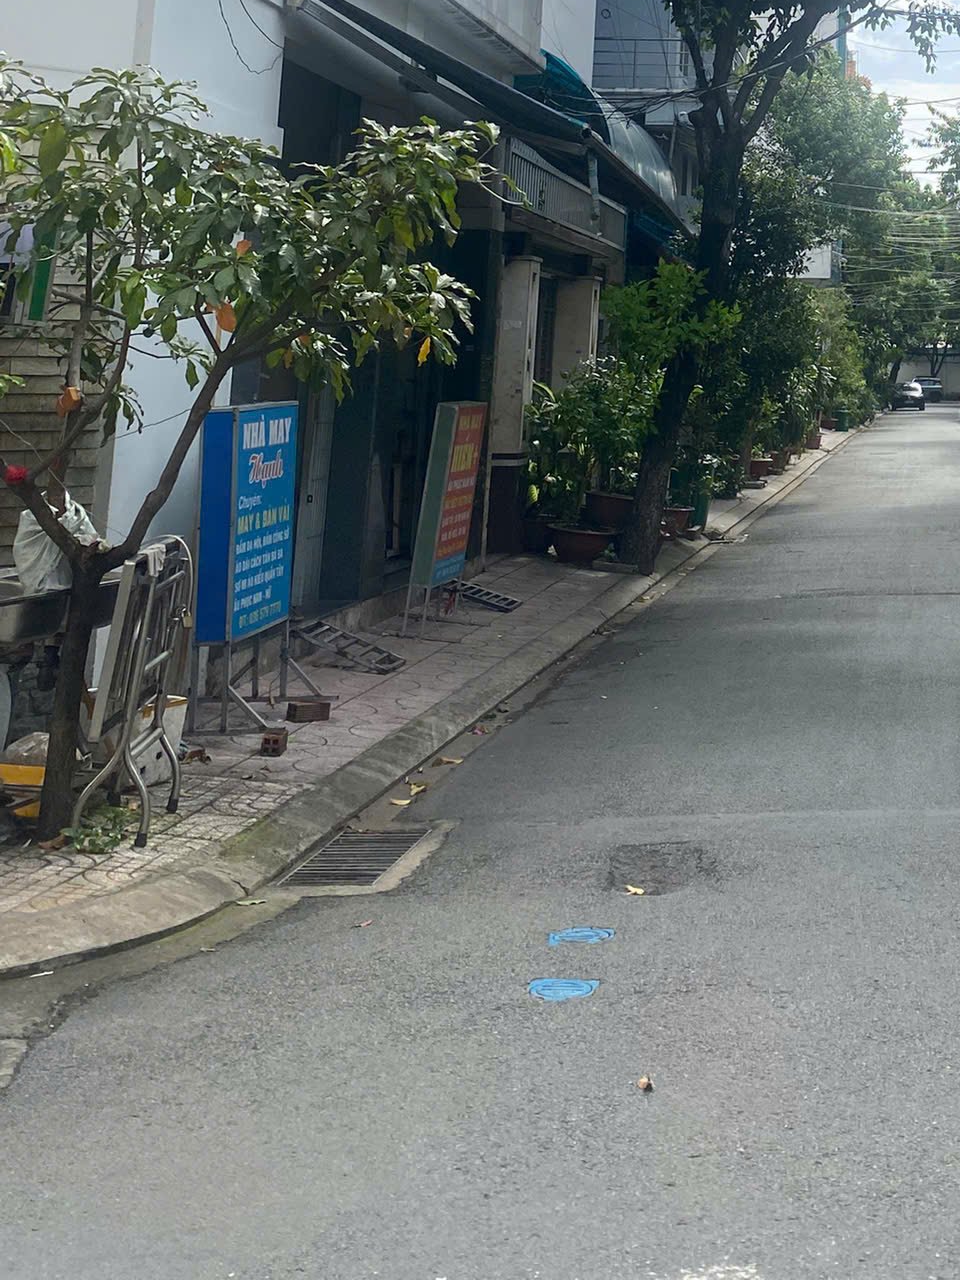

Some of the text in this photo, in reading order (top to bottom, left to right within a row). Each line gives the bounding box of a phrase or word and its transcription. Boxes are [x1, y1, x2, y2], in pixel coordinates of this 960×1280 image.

[243, 414, 292, 450] NHÀ MAY
[237, 513, 254, 535] MAY
[255, 511, 261, 530] &
